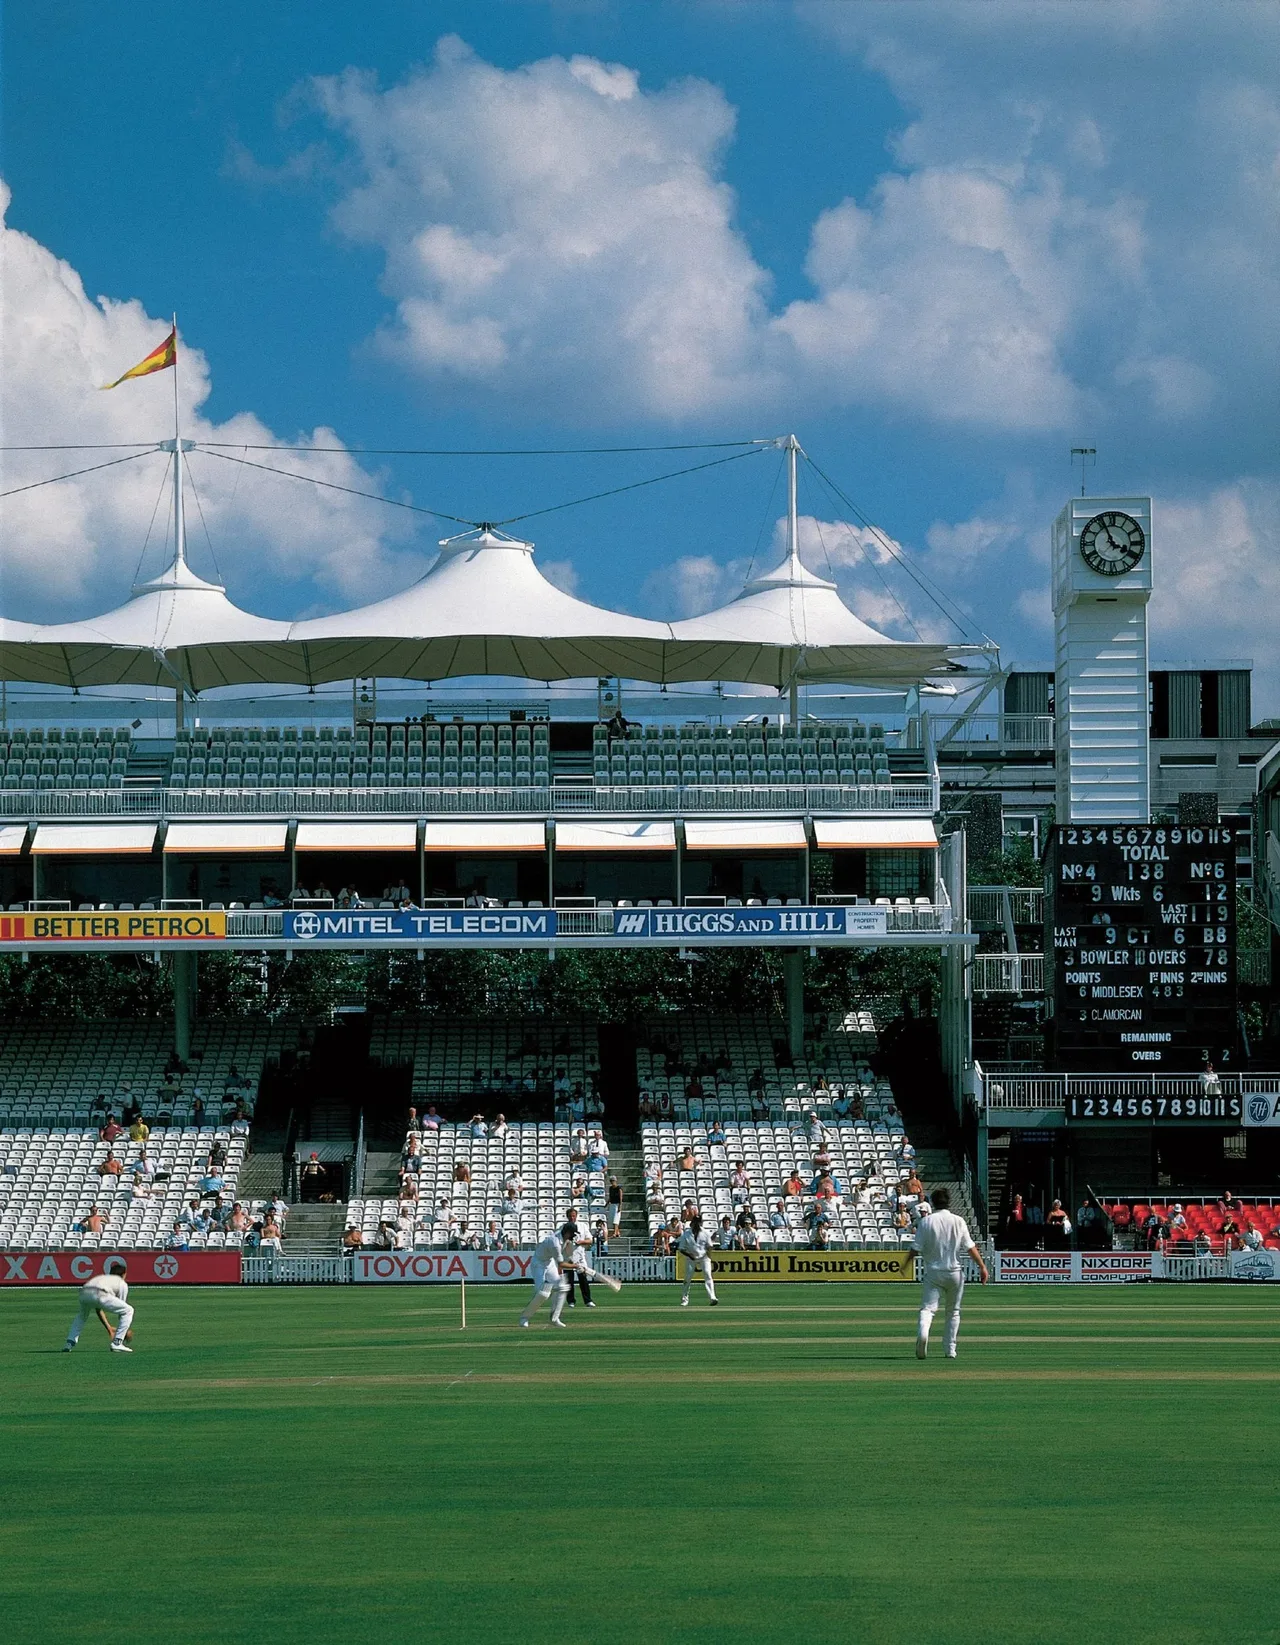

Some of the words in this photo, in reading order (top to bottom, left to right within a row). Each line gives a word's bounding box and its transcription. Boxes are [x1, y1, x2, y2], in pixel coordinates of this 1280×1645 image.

[1068, 830, 1078, 844] 2
[1082, 830, 1092, 844] 3
[1096, 830, 1108, 844] 4
[1112, 830, 1123, 844] 5
[1127, 830, 1138, 844] 6
[1142, 830, 1152, 844] 7
[1155, 830, 1166, 844] 8
[1171, 829, 1182, 844] 9
[1187, 829, 1203, 844] 10
[1222, 829, 1231, 844] S
[1120, 846, 1170, 861] TOTAL
[1086, 864, 1096, 880] 4
[1214, 862, 1224, 878] 6
[1112, 886, 1141, 900] Wkts
[1153, 886, 1164, 901] 6
[1161, 904, 1188, 914] LAST
[324, 916, 402, 933] MITEL
[411, 916, 546, 933] TELECOM
[656, 913, 734, 933] HIGGS
[736, 919, 774, 932] AND
[778, 912, 842, 931] HILL
[1162, 914, 1188, 924] WKT
[34, 918, 119, 936] BETTER
[128, 917, 215, 936] PETROL
[1054, 927, 1076, 936] LAST
[1054, 937, 1076, 947] MAN
[1106, 928, 1116, 944] 9
[1174, 928, 1185, 944] 6
[1080, 950, 1129, 964] BOWLER
[1149, 951, 1186, 964] OVERS
[1066, 972, 1101, 984] POINTS
[1160, 972, 1184, 983] INNS
[1204, 972, 1228, 983] INNS
[1080, 986, 1086, 997] 6
[1092, 986, 1144, 998] MIDDLESEX
[1121, 1033, 1172, 1042] REMAINING
[1132, 1051, 1162, 1060] OVERS
[1084, 1100, 1094, 1116] 2
[1098, 1100, 1108, 1116] 3
[1112, 1100, 1122, 1116] 4
[1128, 1100, 1138, 1116] 5
[1142, 1100, 1152, 1116] 6
[1156, 1100, 1166, 1116] 7
[1170, 1100, 1182, 1116] 8
[1186, 1100, 1196, 1116] 9
[1200, 1100, 1210, 1116] 10
[1230, 1100, 1240, 1116] S
[358, 1256, 468, 1277] TOYOTA
[788, 1256, 900, 1273] Insurance
[1001, 1258, 1071, 1268] NIXDORF
[1082, 1258, 1152, 1268] NIXDORF
